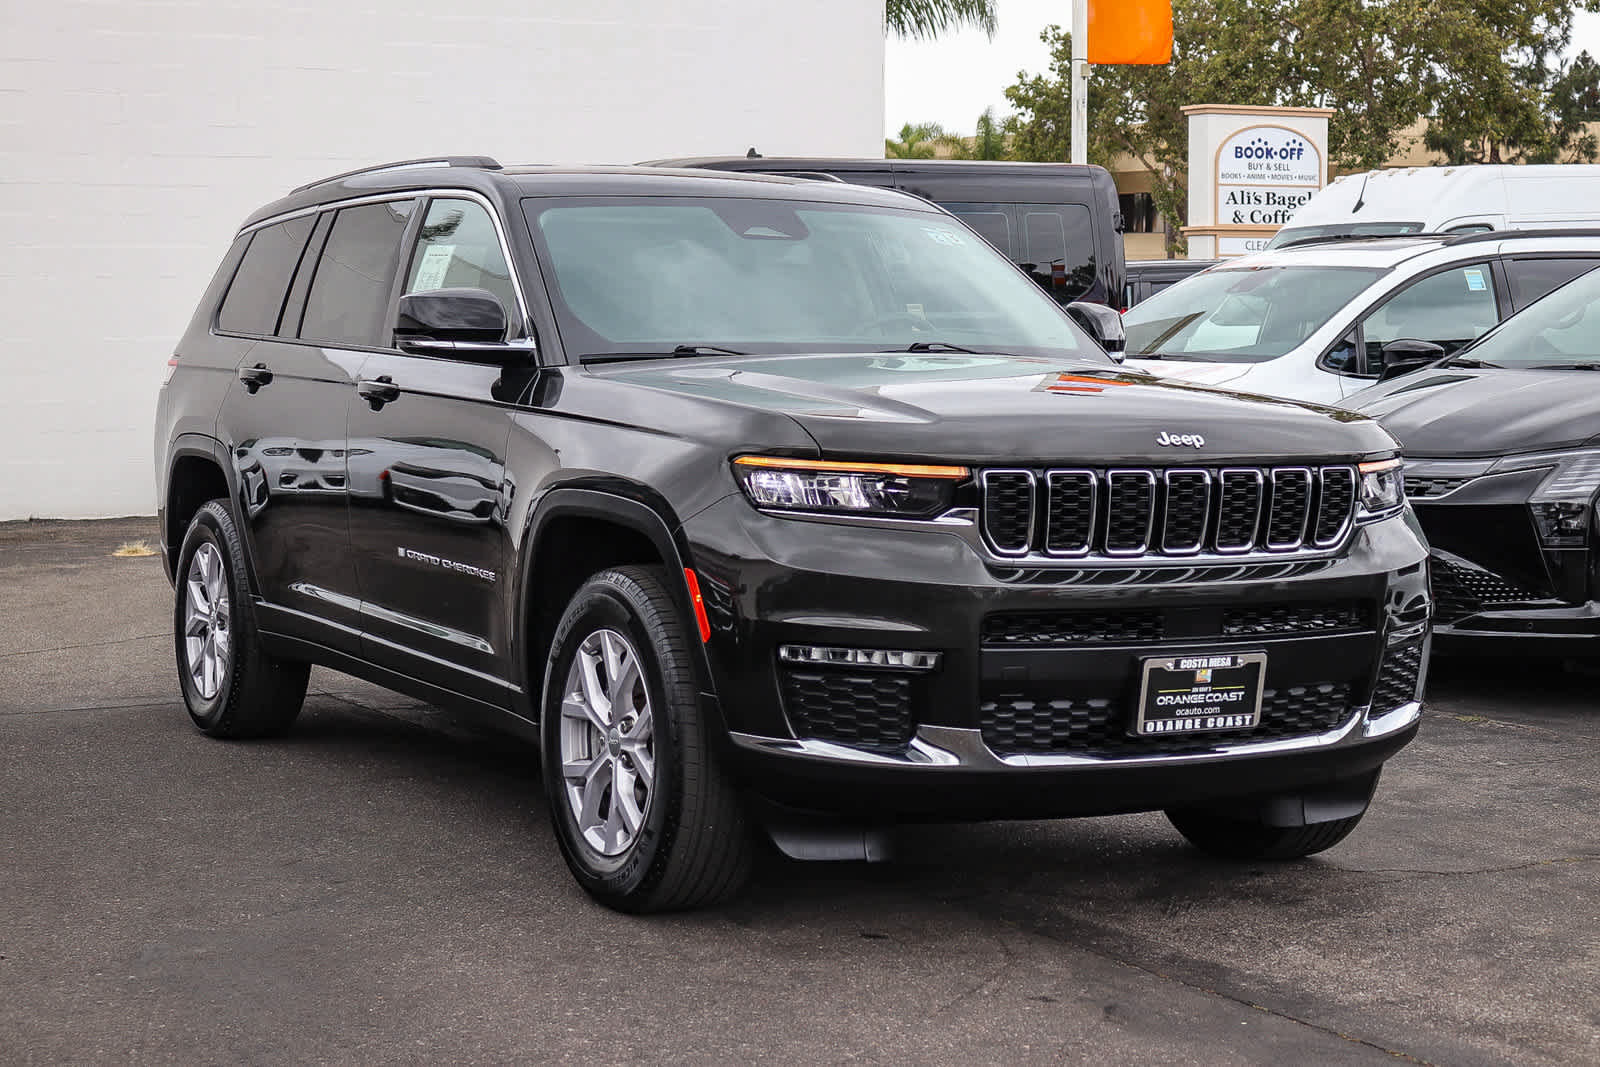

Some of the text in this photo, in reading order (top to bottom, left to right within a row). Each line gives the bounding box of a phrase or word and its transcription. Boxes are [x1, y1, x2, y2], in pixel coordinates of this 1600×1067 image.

[1248, 162, 1290, 171] BUY & SELL
[1225, 190, 1262, 205] Ali's
[1232, 210, 1245, 224] &
[1156, 431, 1205, 449] Jeep
[406, 550, 496, 582] GRAND CHEROKEE
[1180, 656, 1232, 669] COSTA MESA
[1175, 706, 1220, 717] ocauto.com
[1146, 715, 1252, 732] ORANGE COAST
